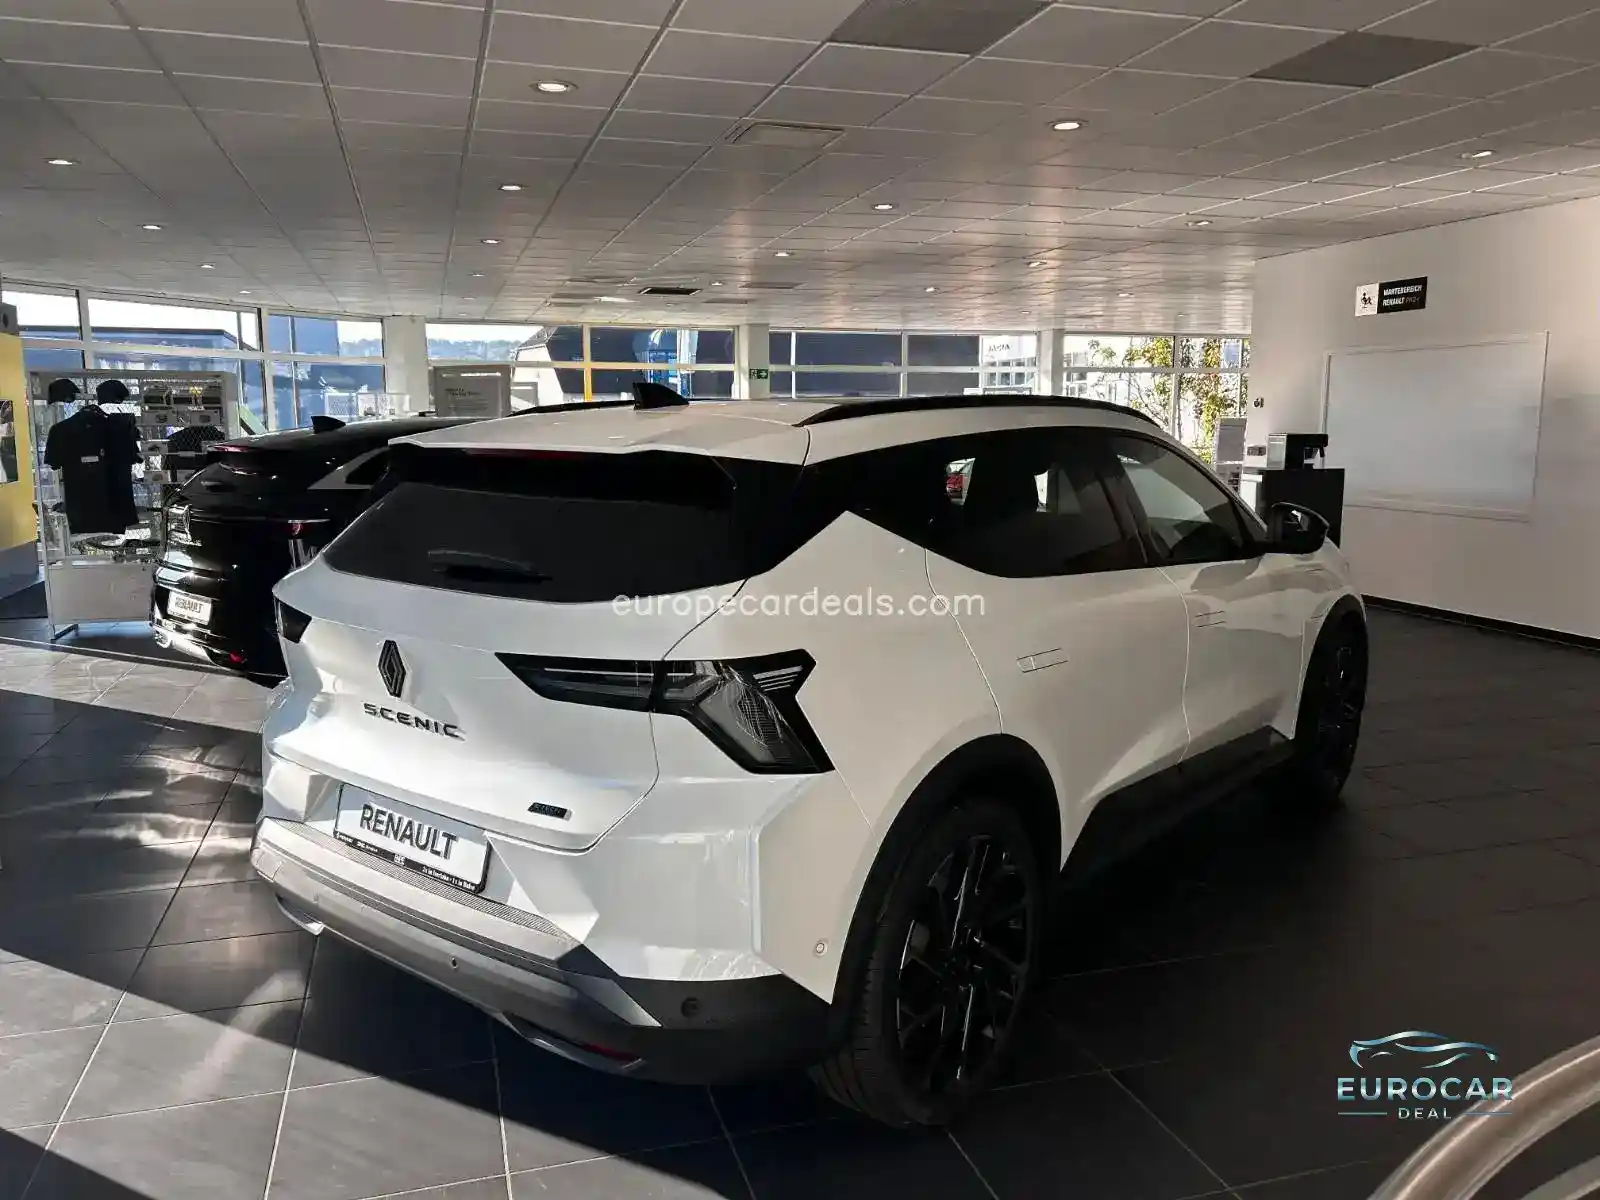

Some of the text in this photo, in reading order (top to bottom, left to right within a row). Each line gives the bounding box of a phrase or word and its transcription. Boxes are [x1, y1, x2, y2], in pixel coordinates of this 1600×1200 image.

[1382, 297, 1405, 306] RENAULT
[363, 703, 462, 740] SCENIC
[360, 804, 458, 859] RENAULT
